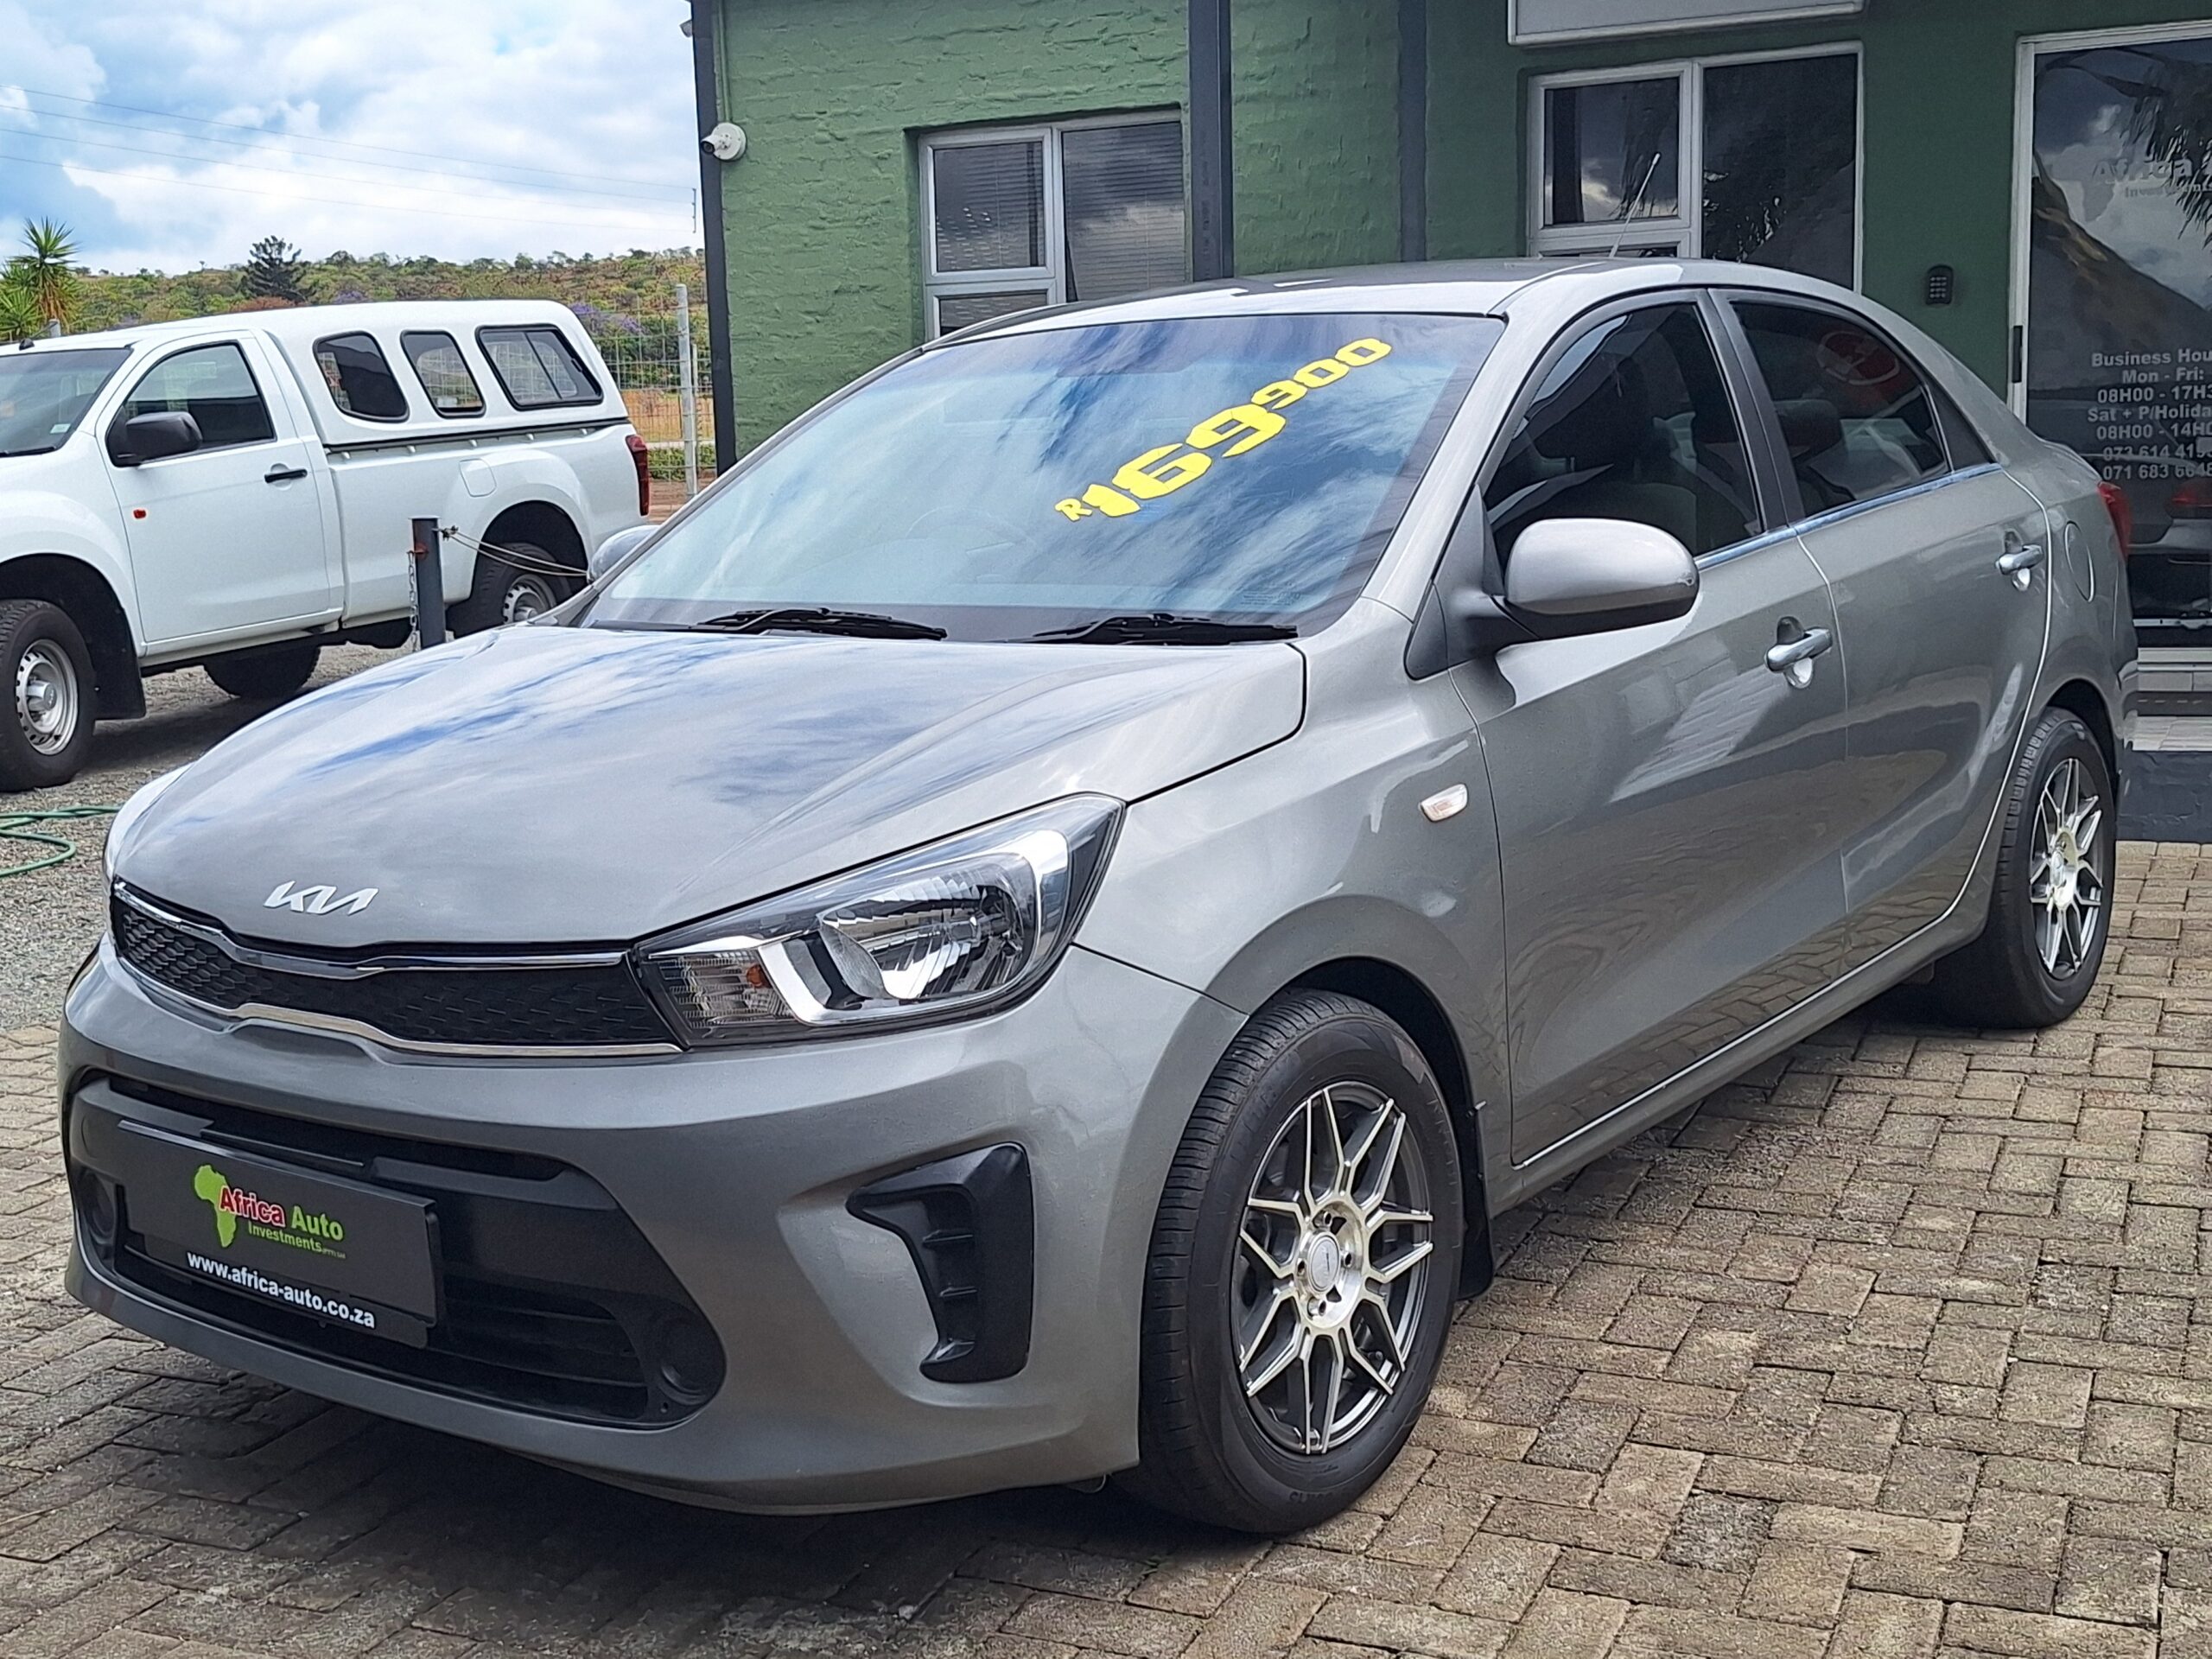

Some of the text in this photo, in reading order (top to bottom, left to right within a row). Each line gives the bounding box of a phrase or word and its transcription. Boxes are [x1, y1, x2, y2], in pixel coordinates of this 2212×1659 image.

[2091, 351, 2171, 367] Business
[2122, 369, 2158, 384] Mon
[2177, 366, 2204, 381] Fri:
[2097, 387, 2154, 404] 08H00
[2087, 407, 2116, 423] Sat
[2096, 423, 2153, 440] 08H00
[2102, 464, 2132, 480] 071
[2139, 464, 2170, 480] 683
[219, 1185, 344, 1241] Africa Auto
[248, 1220, 323, 1253] Investments
[187, 1252, 376, 1328] www.africa-auto.co.za
